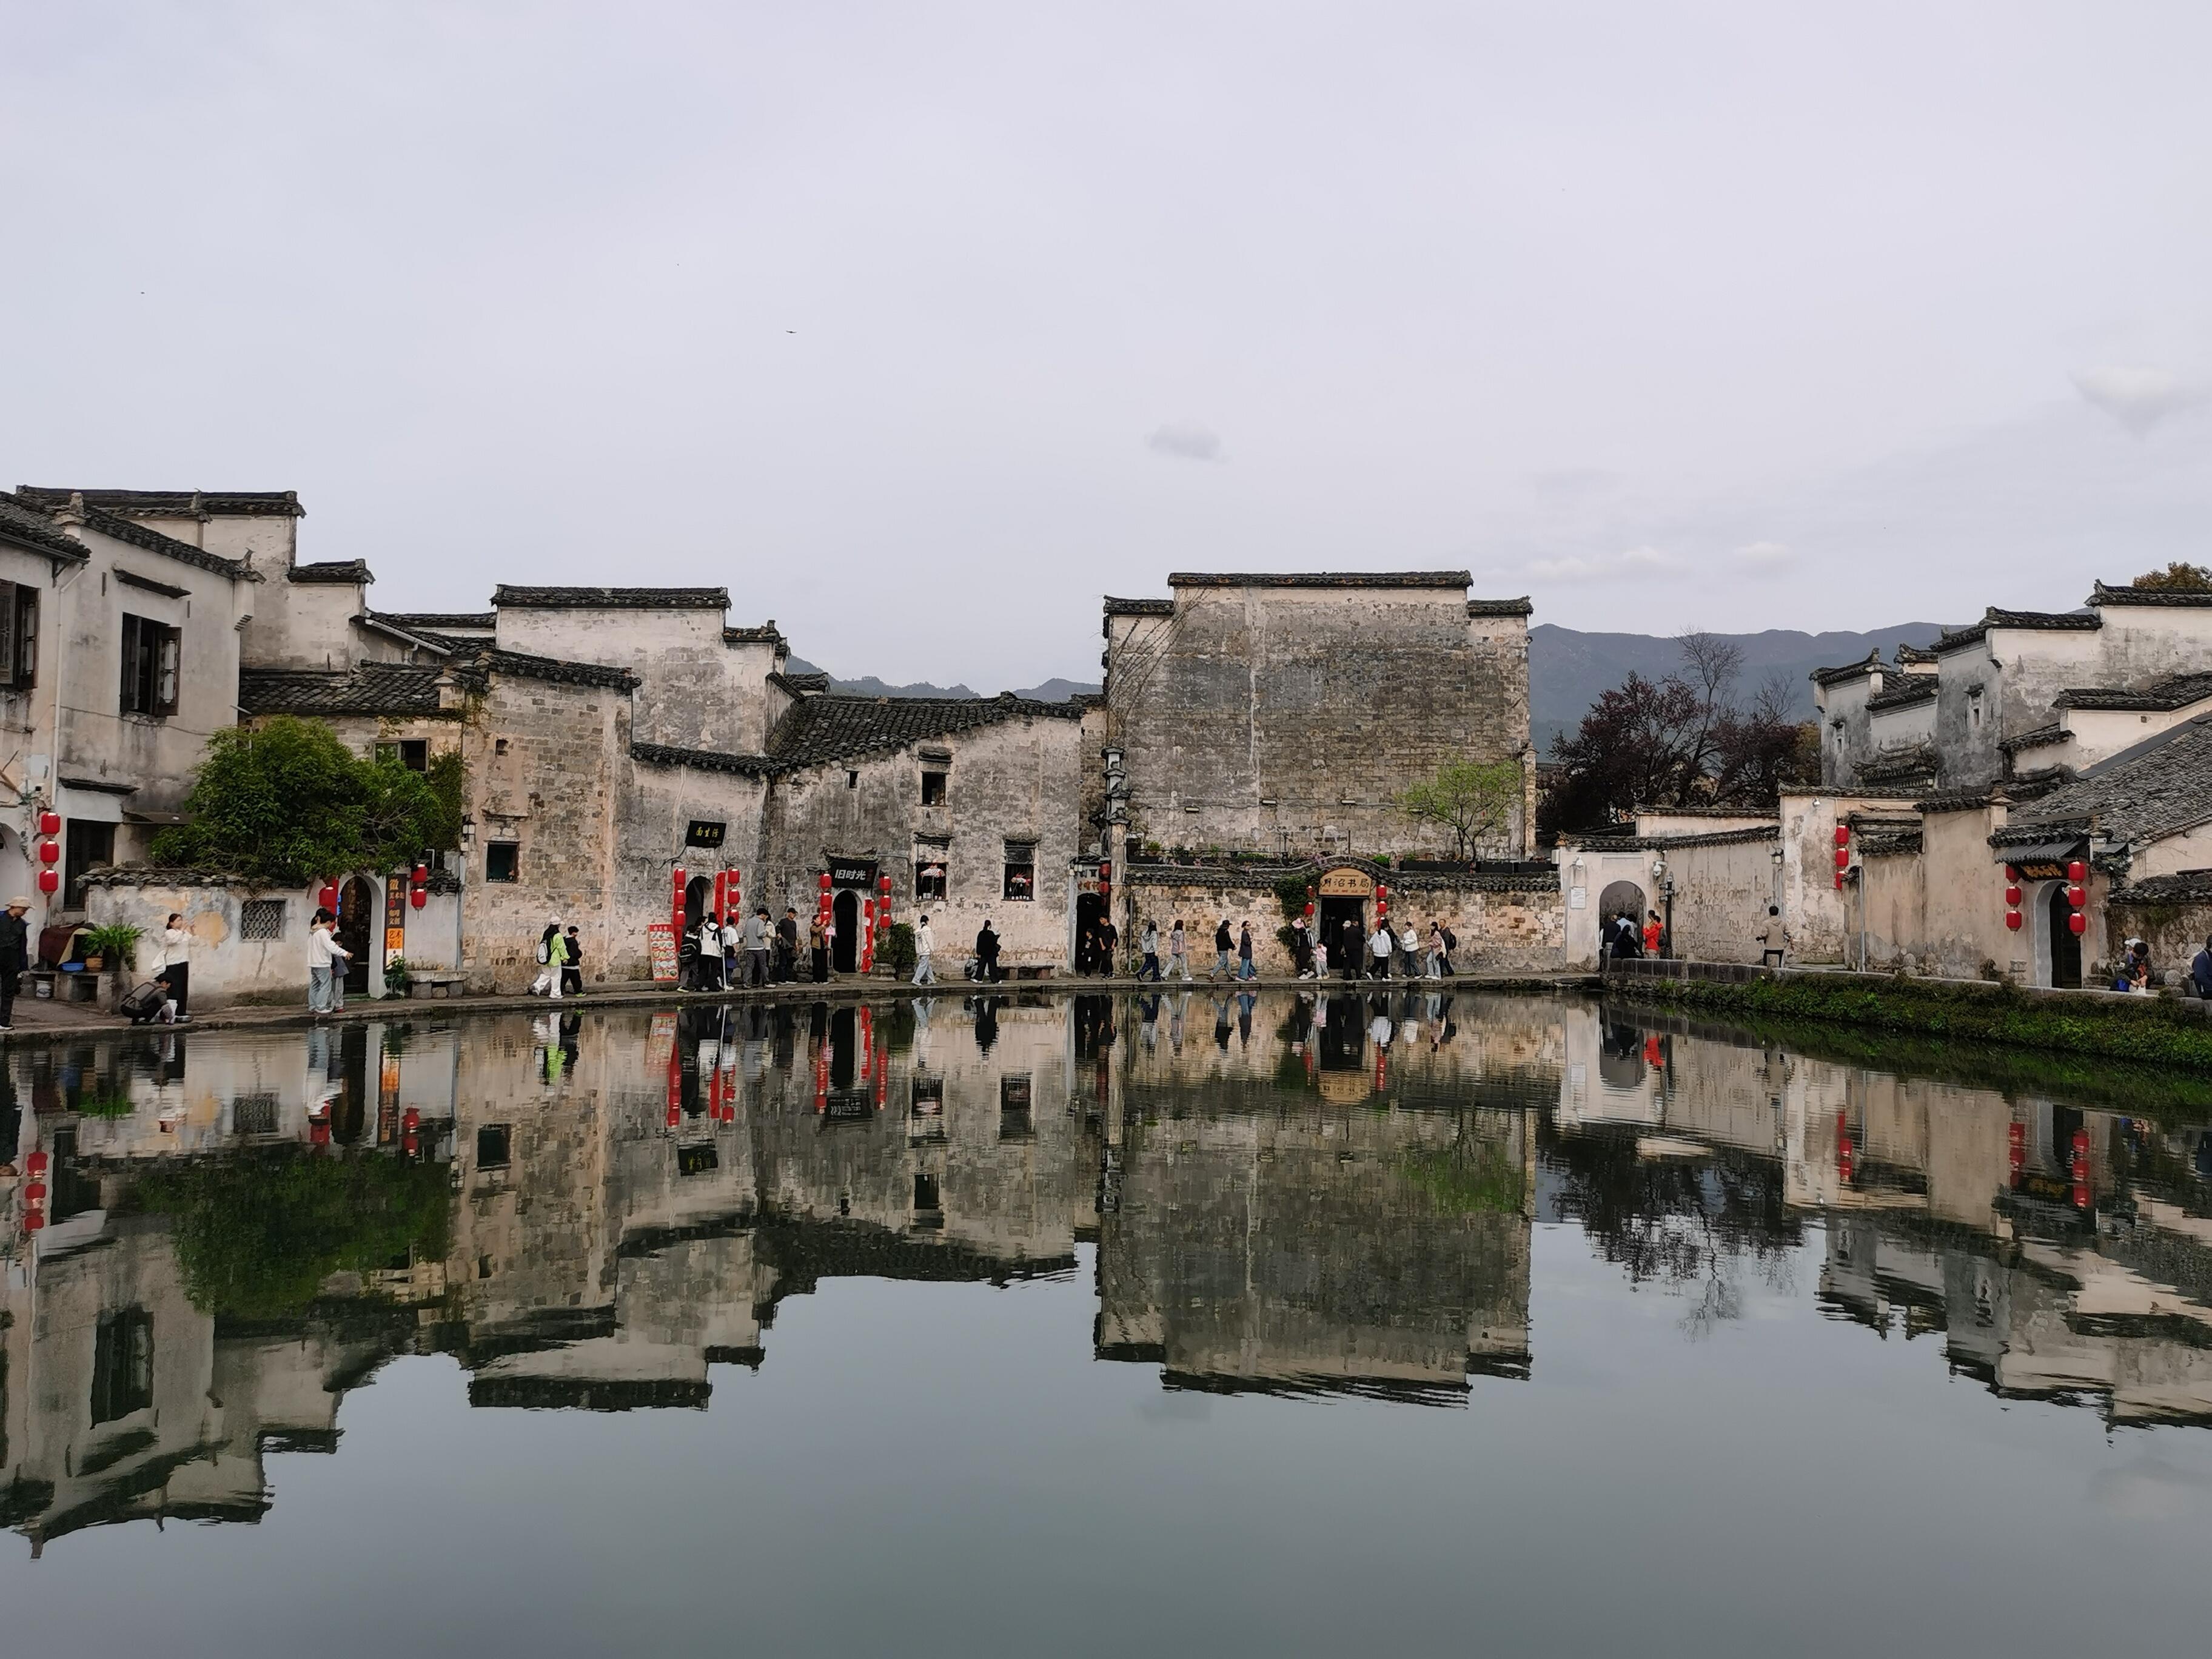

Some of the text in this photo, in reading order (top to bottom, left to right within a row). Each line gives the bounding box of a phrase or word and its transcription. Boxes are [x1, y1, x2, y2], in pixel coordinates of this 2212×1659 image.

[834, 869, 866, 880] 旧时光
[1322, 878, 1369, 888] 月沼书局
